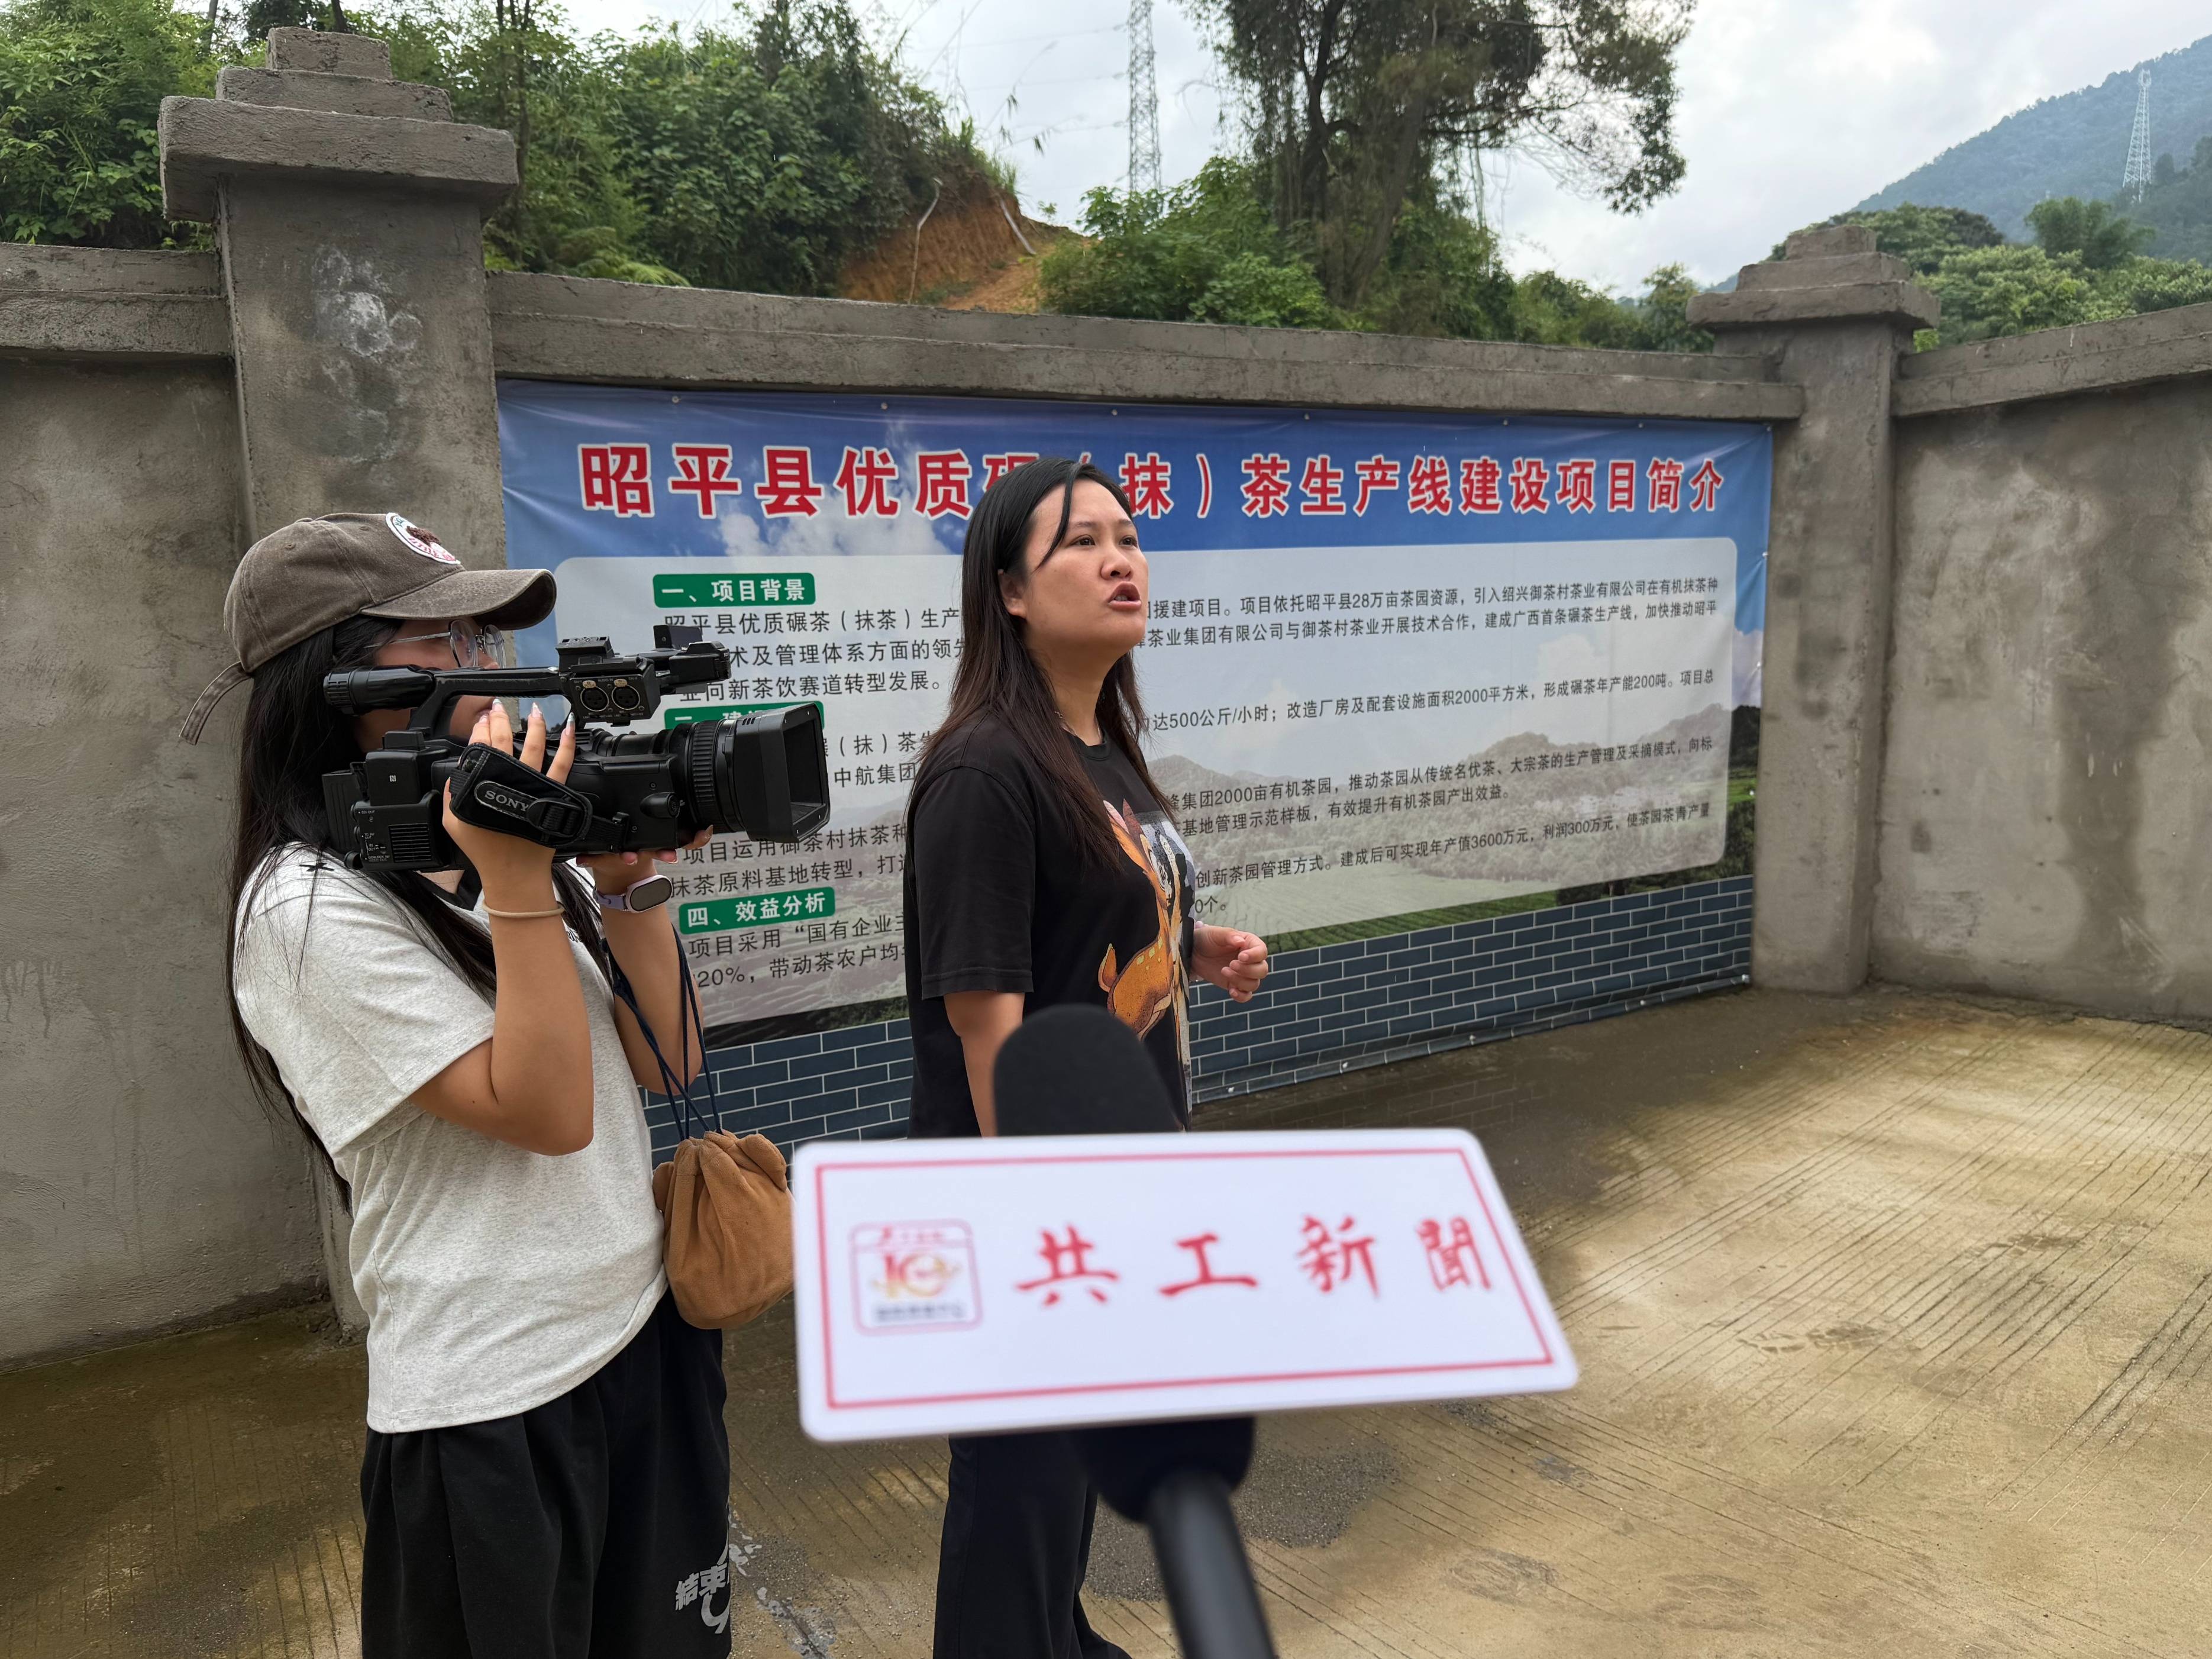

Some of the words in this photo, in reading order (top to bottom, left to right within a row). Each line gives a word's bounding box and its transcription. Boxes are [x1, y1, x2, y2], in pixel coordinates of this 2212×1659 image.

[579, 444, 1723, 519] 昭平县优质抹）茶生产线建设项目简介
[661, 579, 806, 603] 一、项目背景
[1147, 577, 1718, 619] 援建项目。项目依托昭平县28万亩茶园资源，引入绍兴御茶村茶业有限公司在有机抹茶种
[834, 762, 916, 787] 中航集团
[484, 789, 529, 812] SONY
[1175, 783, 1509, 837] 基地管理示范样板，有效提升有机茶园产出效益。
[687, 892, 826, 927] 四、效益分析
[693, 943, 905, 987] 20%，带动茶农户均
[1195, 895, 1226, 913] 0个。
